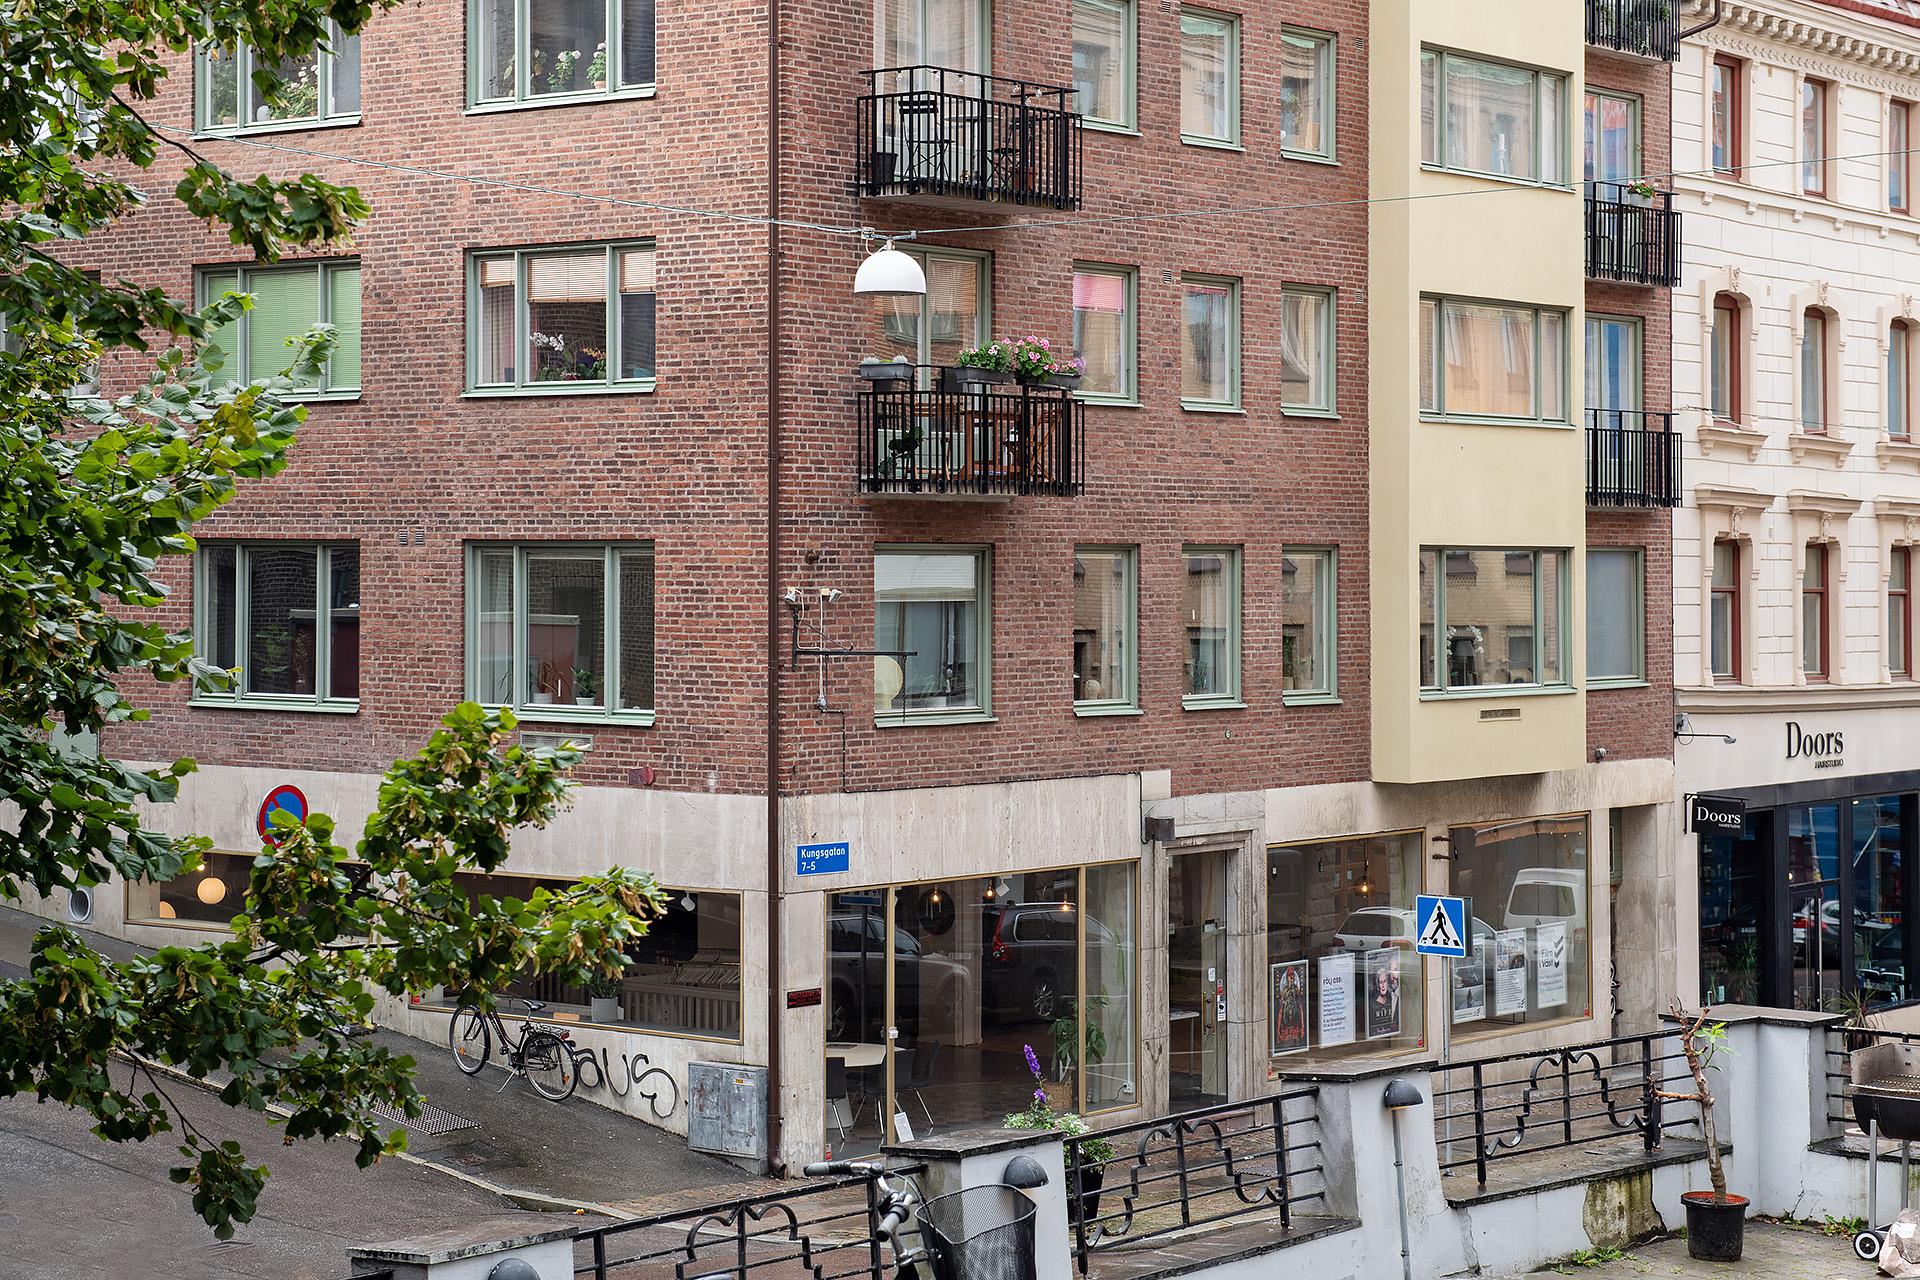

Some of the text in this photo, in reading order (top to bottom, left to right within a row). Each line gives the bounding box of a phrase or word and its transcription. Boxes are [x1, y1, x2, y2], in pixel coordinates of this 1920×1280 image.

[1786, 721, 1843, 758] Doors
[1814, 758, 1844, 769] HAIRSTUDIO
[1696, 806, 1741, 824] Doors
[801, 847, 846, 860] Kungsgatan
[801, 861, 816, 872] 7-5
[1542, 949, 1553, 958] Film
